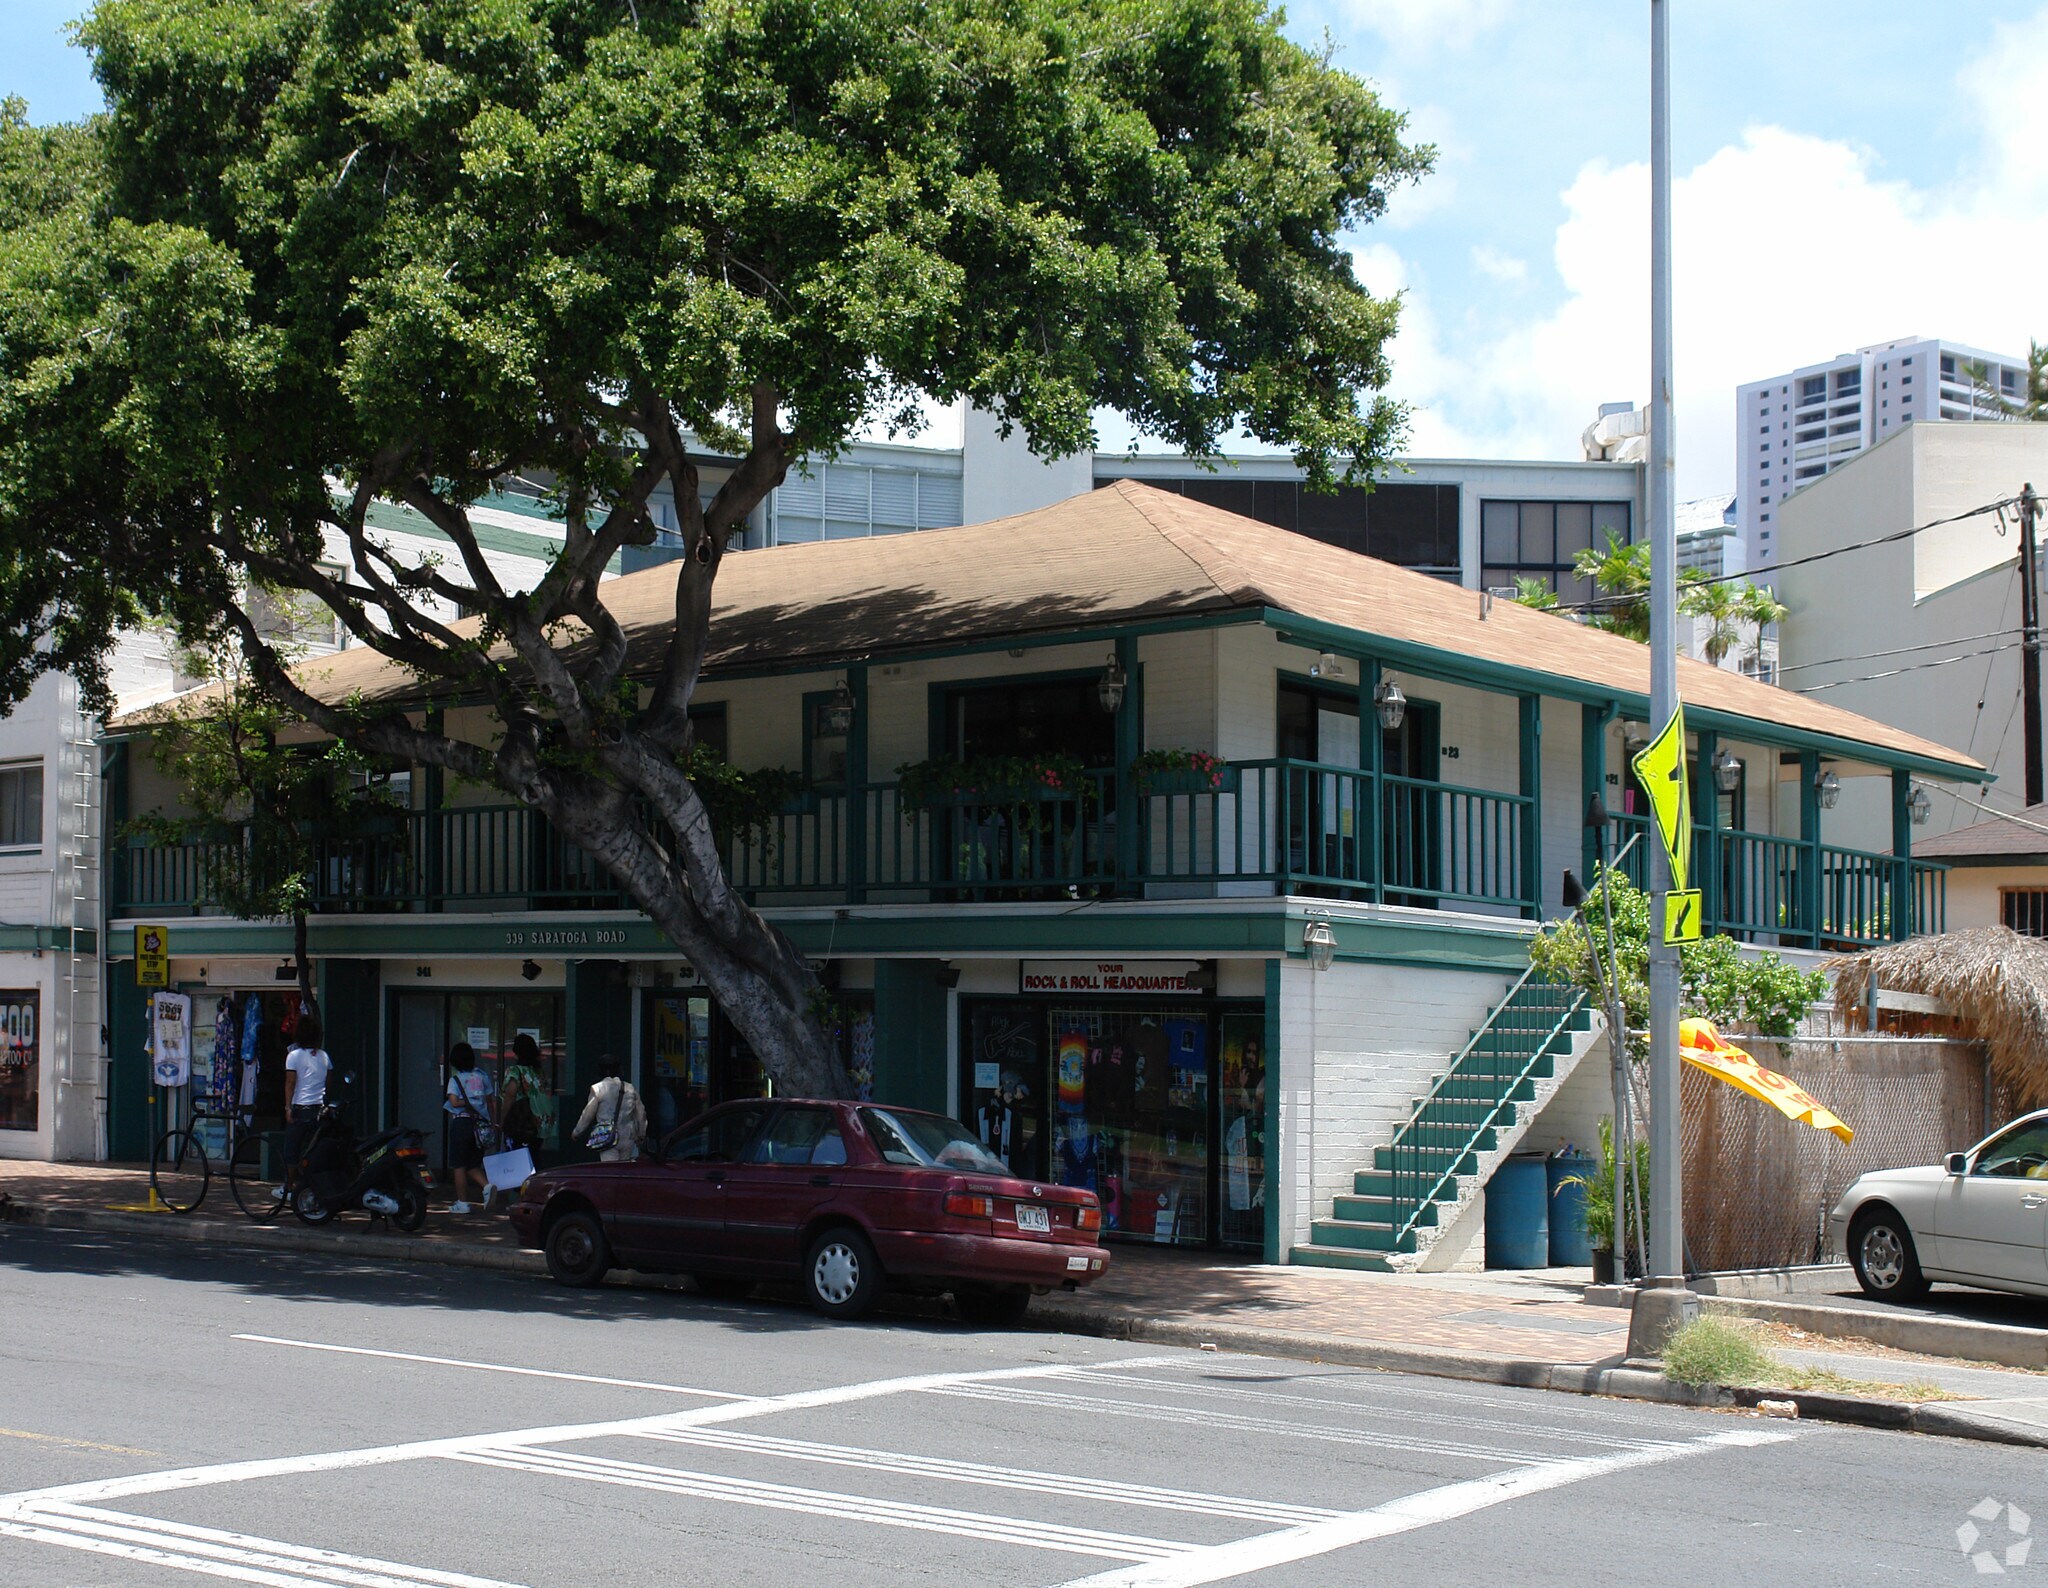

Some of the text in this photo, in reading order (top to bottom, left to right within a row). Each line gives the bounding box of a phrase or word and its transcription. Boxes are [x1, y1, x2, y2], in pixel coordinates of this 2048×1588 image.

[506, 930, 626, 944] 339 SARATOGA ROAD
[416, 966, 432, 977] 341
[1097, 964, 1124, 973] YOUR
[1025, 975, 1199, 991] ROCK & ROLL HEADQUARTE
